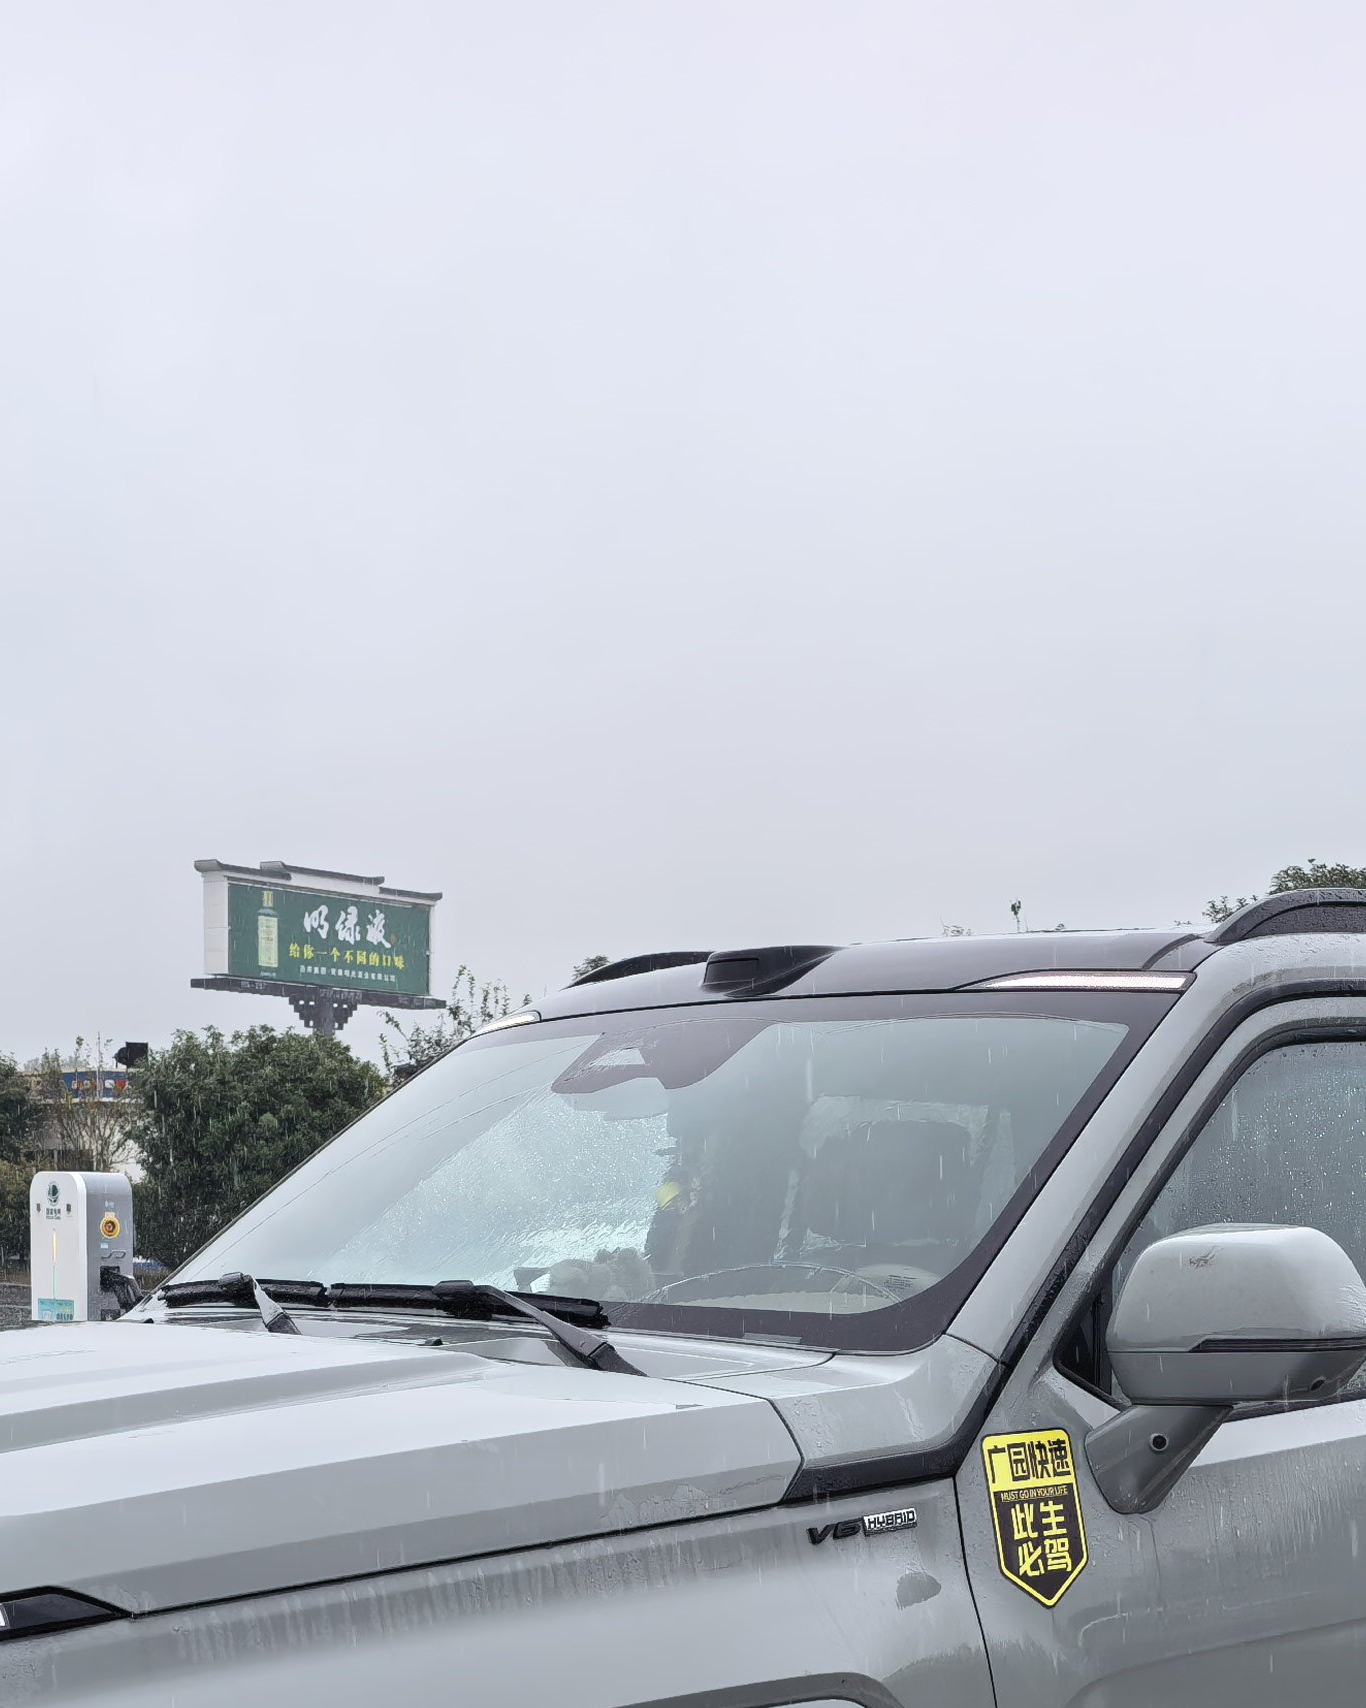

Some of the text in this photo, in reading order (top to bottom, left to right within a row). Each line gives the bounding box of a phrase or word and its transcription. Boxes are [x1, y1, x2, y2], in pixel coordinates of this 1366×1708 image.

[289, 942, 405, 970] 给你一个不同的口味
[987, 1437, 1072, 1485] 广园快速
[1000, 1485, 1068, 1502] MUST GO IN YOUR LIFE
[806, 1508, 916, 1545] V6 HYBRID
[1010, 1500, 1068, 1541] 此生
[1018, 1537, 1073, 1577] 必驾
